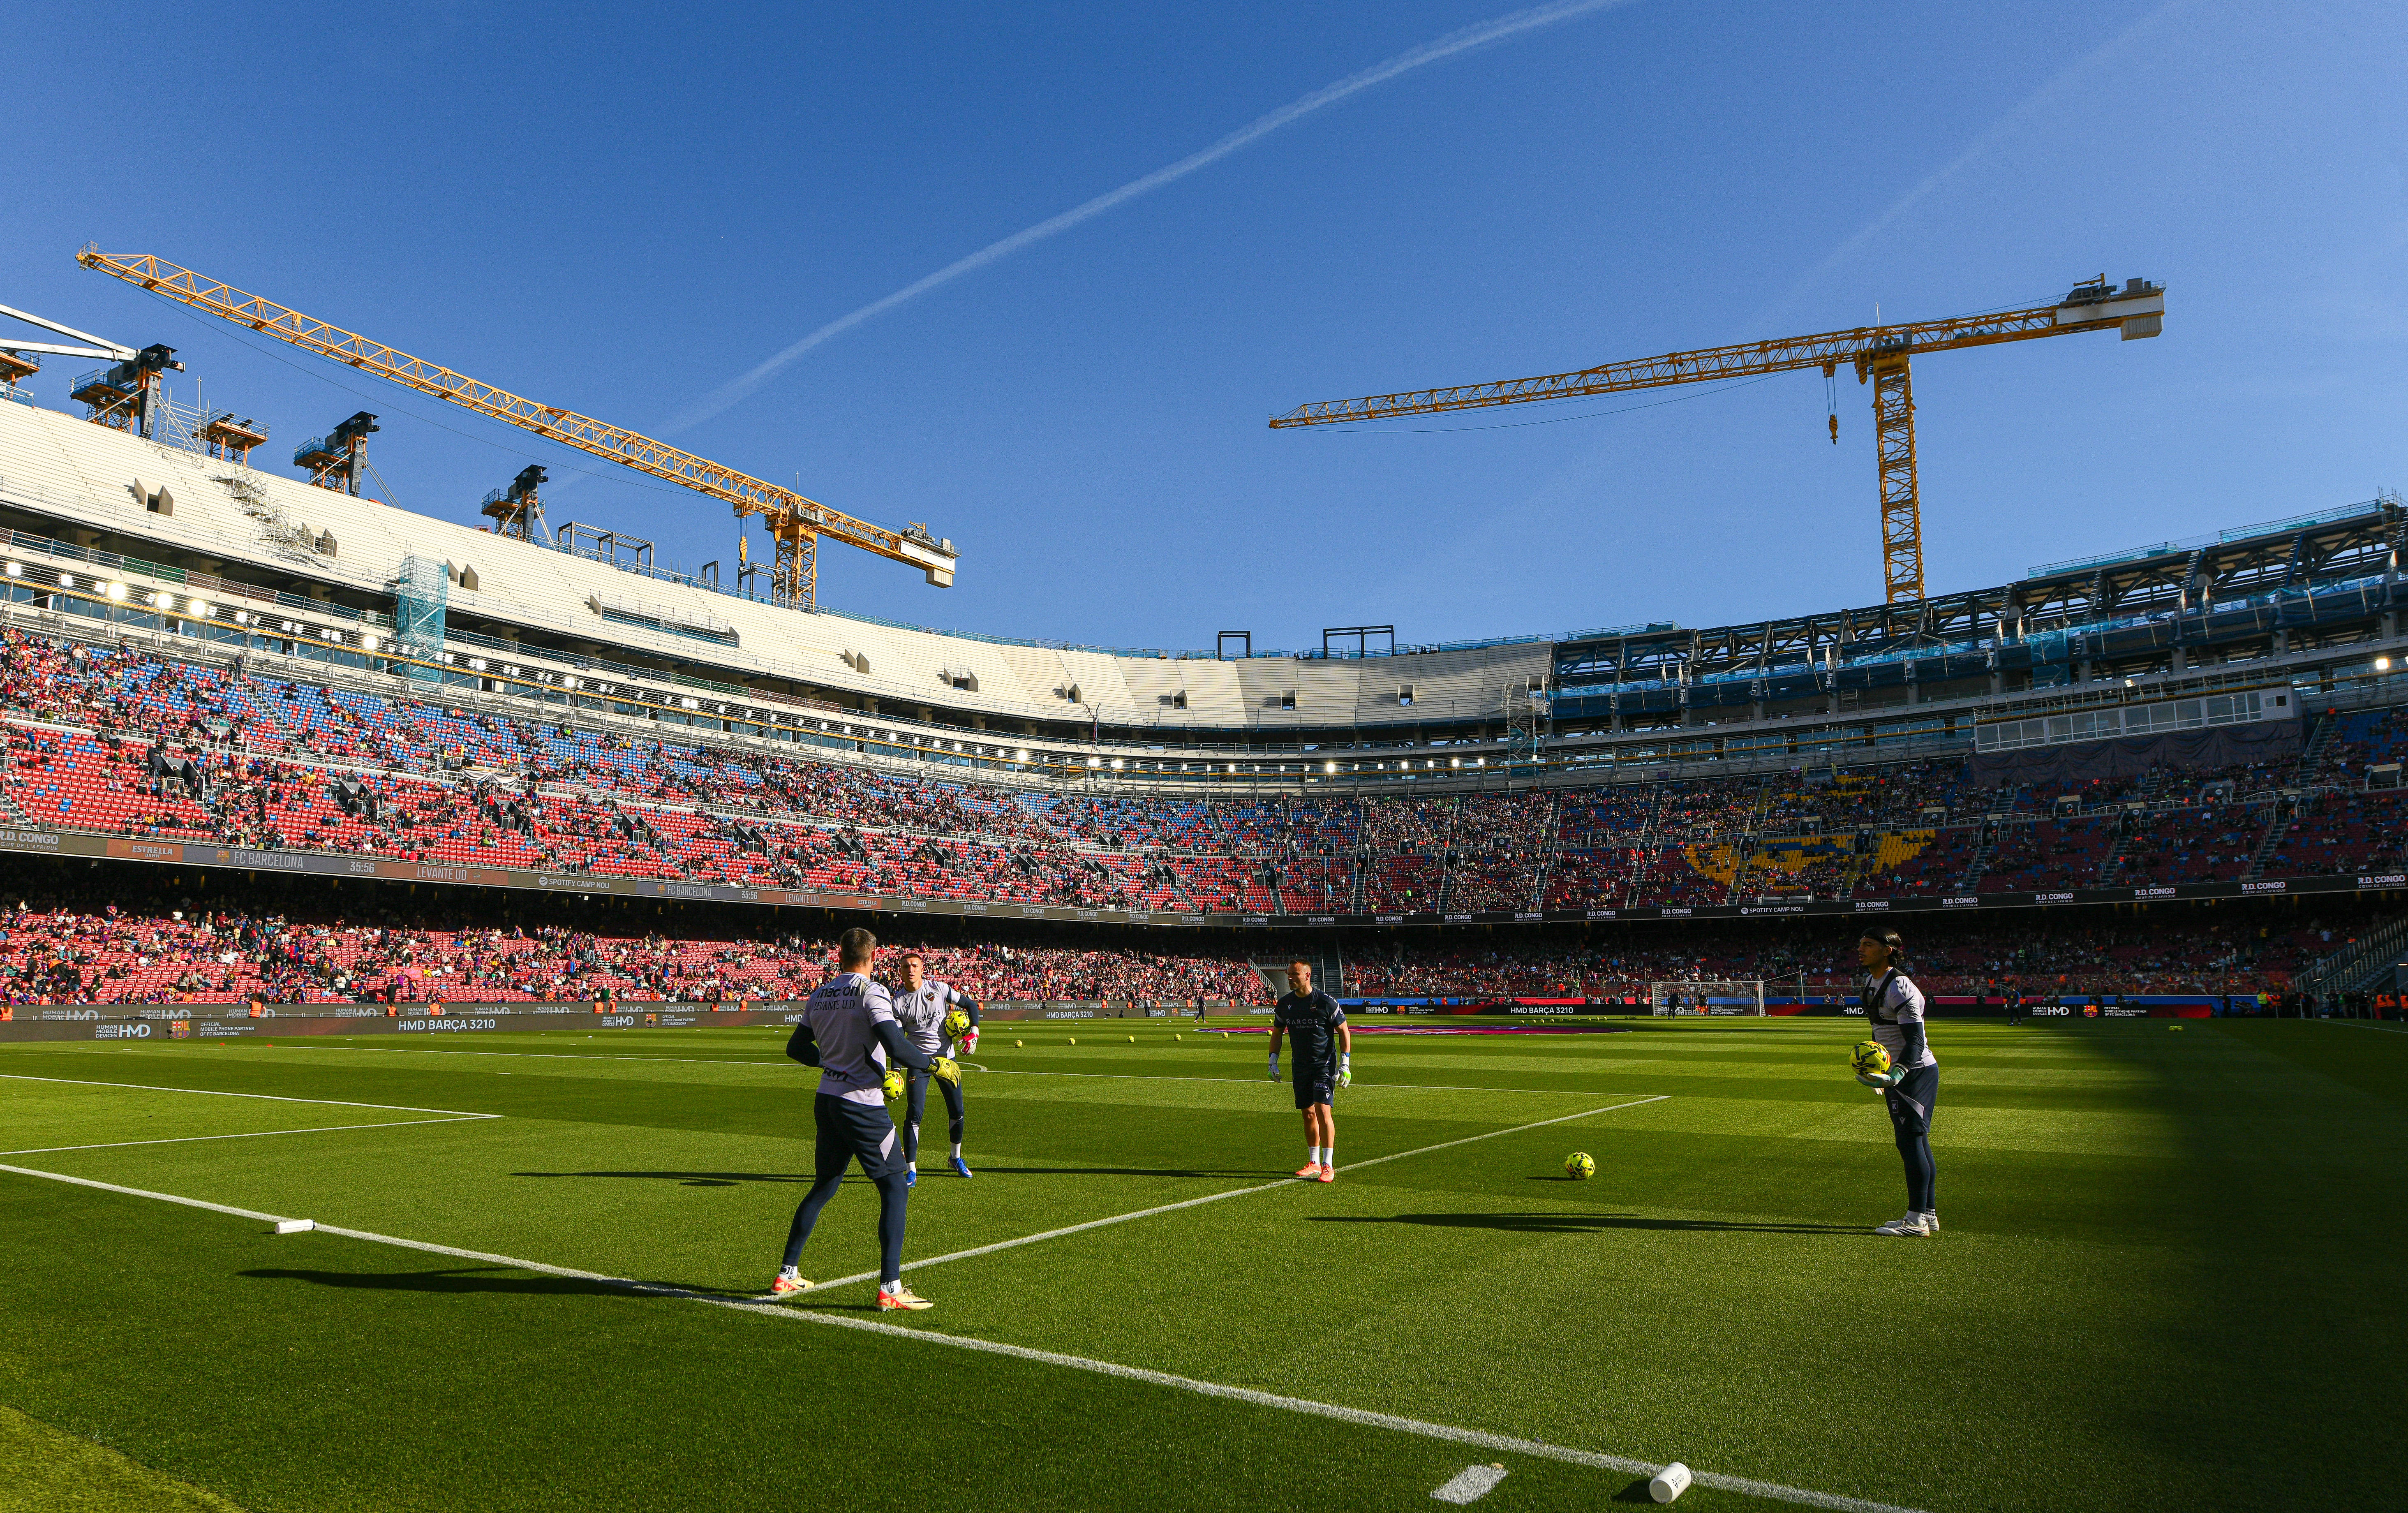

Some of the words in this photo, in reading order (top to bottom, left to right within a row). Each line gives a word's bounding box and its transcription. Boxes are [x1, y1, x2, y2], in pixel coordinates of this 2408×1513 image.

[19, 832, 59, 844] CONGO
[132, 845, 173, 855] ESTRELLA
[234, 851, 246, 864] FC
[248, 852, 303, 868] BARCELONA
[350, 861, 374, 873] 35:56
[417, 866, 453, 879] LEVANTE
[455, 868, 467, 881] UD
[2374, 875, 2405, 883] CONGO
[549, 879, 575, 887] SPOTIFY
[577, 880, 595, 888] CAMP
[668, 885, 676, 895] FC
[677, 885, 712, 897] BARCELONA
[741, 890, 758, 900] 35:56
[786, 893, 810, 904] LEVANTE
[811, 895, 819, 905] UD
[813, 1000, 840, 1011] LEVANTE
[842, 999, 855, 1009] U.D.
[66, 1010, 99, 1020] HMD
[1061, 1011, 1079, 1020] BARÇA
[1529, 1007, 1555, 1015] BARÇA
[2047, 1007, 2069, 1015] HMD
[398, 1020, 425, 1031] HMD
[428, 1019, 467, 1032] BARÇA
[469, 1019, 495, 1029] 3210
[616, 1016, 634, 1026] HMD
[119, 1024, 151, 1038] HMD
